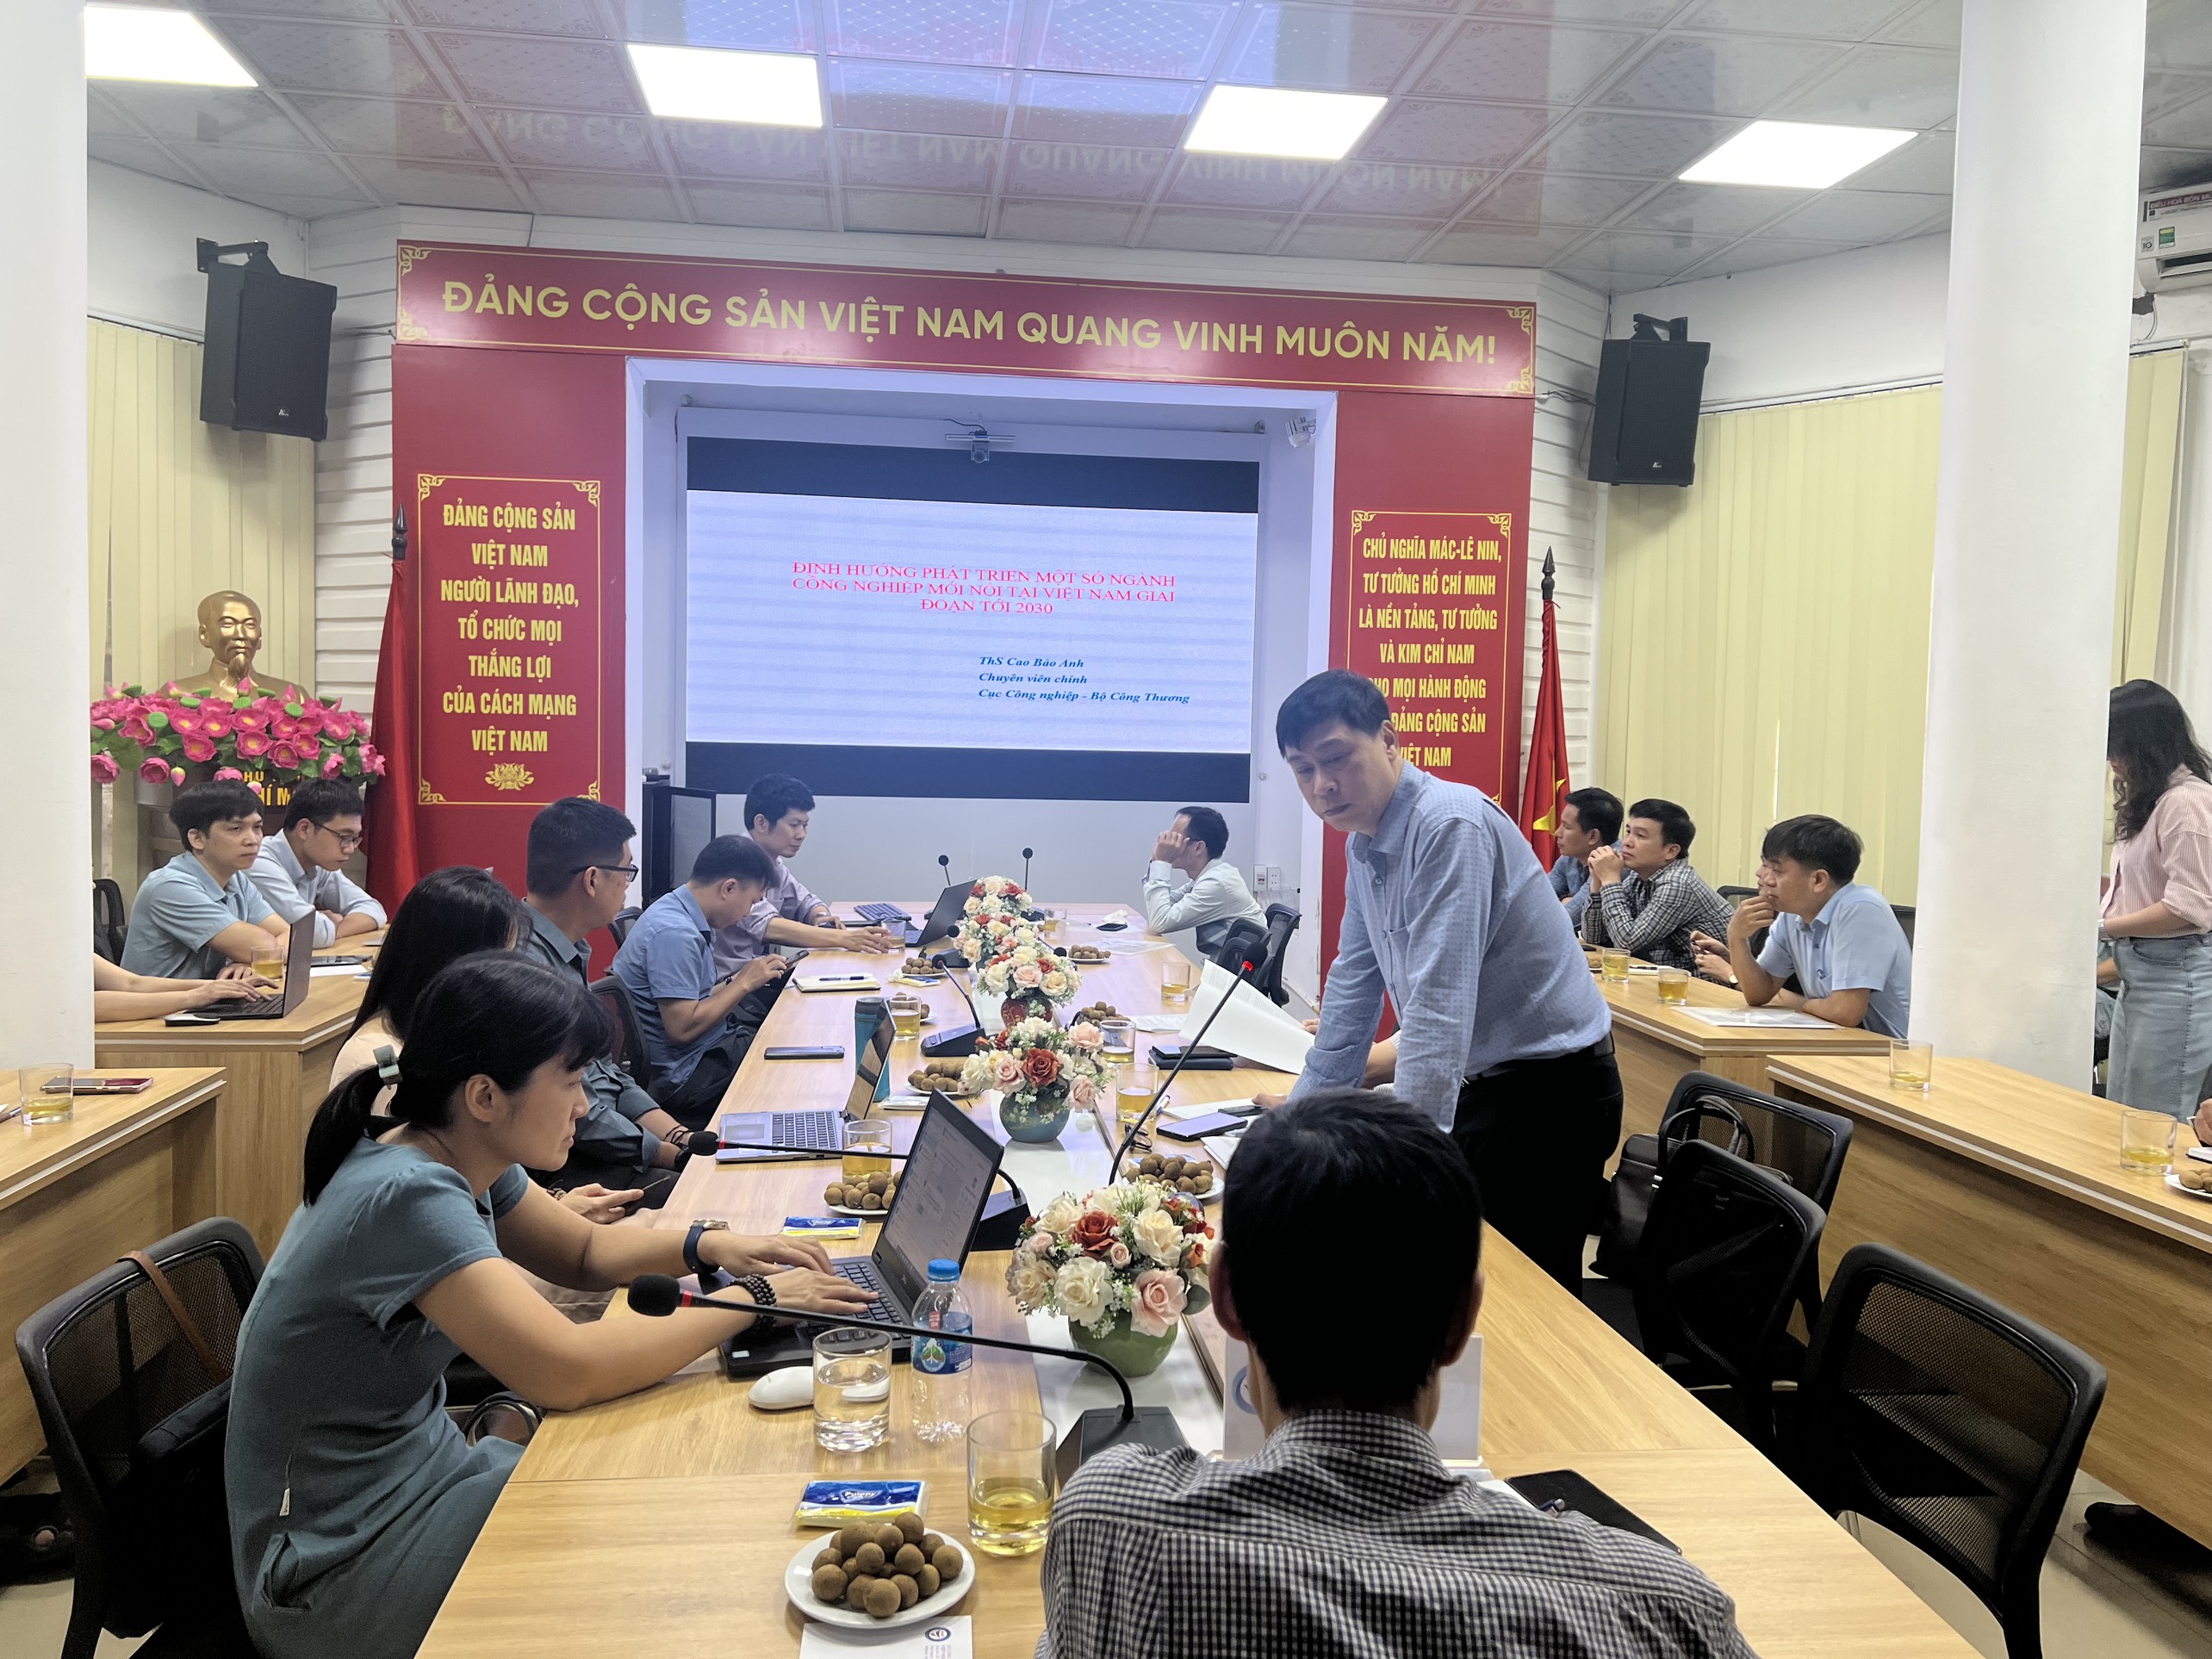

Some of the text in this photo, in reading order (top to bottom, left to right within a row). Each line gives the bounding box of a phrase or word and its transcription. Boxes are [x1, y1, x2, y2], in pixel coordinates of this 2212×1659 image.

[444, 276, 1494, 363] ĐẢNG CỘNG SẢN VIỆT NAM QUANG VINH MUÔN NĂM!
[444, 498, 575, 533] ĐẢNG CỘNG SẢN
[472, 538, 548, 569] VIỆT NAM
[1363, 531, 1501, 562] CHỦ NGHĨA MÁC-LÊ NIN,
[792, 575, 848, 591] CÔNG
[928, 581, 964, 595] MỚI
[1008, 587, 1038, 600] TẠI
[1043, 587, 1084, 601] VIỆT
[1090, 589, 1131, 601] NAM
[1137, 591, 1175, 602] GIAI
[846, 562, 917, 578] HƯỚNG
[923, 565, 972, 581] PHÁT
[1110, 572, 1176, 587] NGÀNH
[1363, 568, 1495, 595] TƯ TƯỞNG HỒ CHÍ MINH
[441, 575, 579, 609] NGƯỜI LÃNH ĐẠO,
[921, 599, 1053, 613] ĐOẠN TỚI 2030
[458, 610, 562, 645] TỔ CHỨC MỌI
[1359, 602, 1497, 631] LÀ NỀN TẢNG, TƯ TƯỞNG
[979, 656, 1003, 665] ThS
[1007, 658, 1029, 667] Cao
[1059, 659, 1084, 668] Anh
[1380, 637, 1475, 664] VÀ KIM CHỈ NAM
[469, 648, 551, 683] THẮNG LỢI
[979, 673, 1087, 684] Chuyên viên chính
[444, 685, 576, 720] CỦA CÁCH MẠNG
[979, 689, 1002, 699] Cục
[1006, 690, 1036, 700] Công
[1040, 691, 1078, 702] nghiệp
[1090, 692, 1106, 702] Bộ
[1110, 693, 1140, 703] Công
[1145, 693, 1190, 704] Thương
[1369, 674, 1486, 703] HO MỌI HÀNH ĐỘNG
[1426, 709, 1458, 736] CỘNG
[1462, 706, 1486, 733] SẢN
[472, 726, 547, 756] VIỆT NAM
[1425, 747, 1451, 767] NAM
